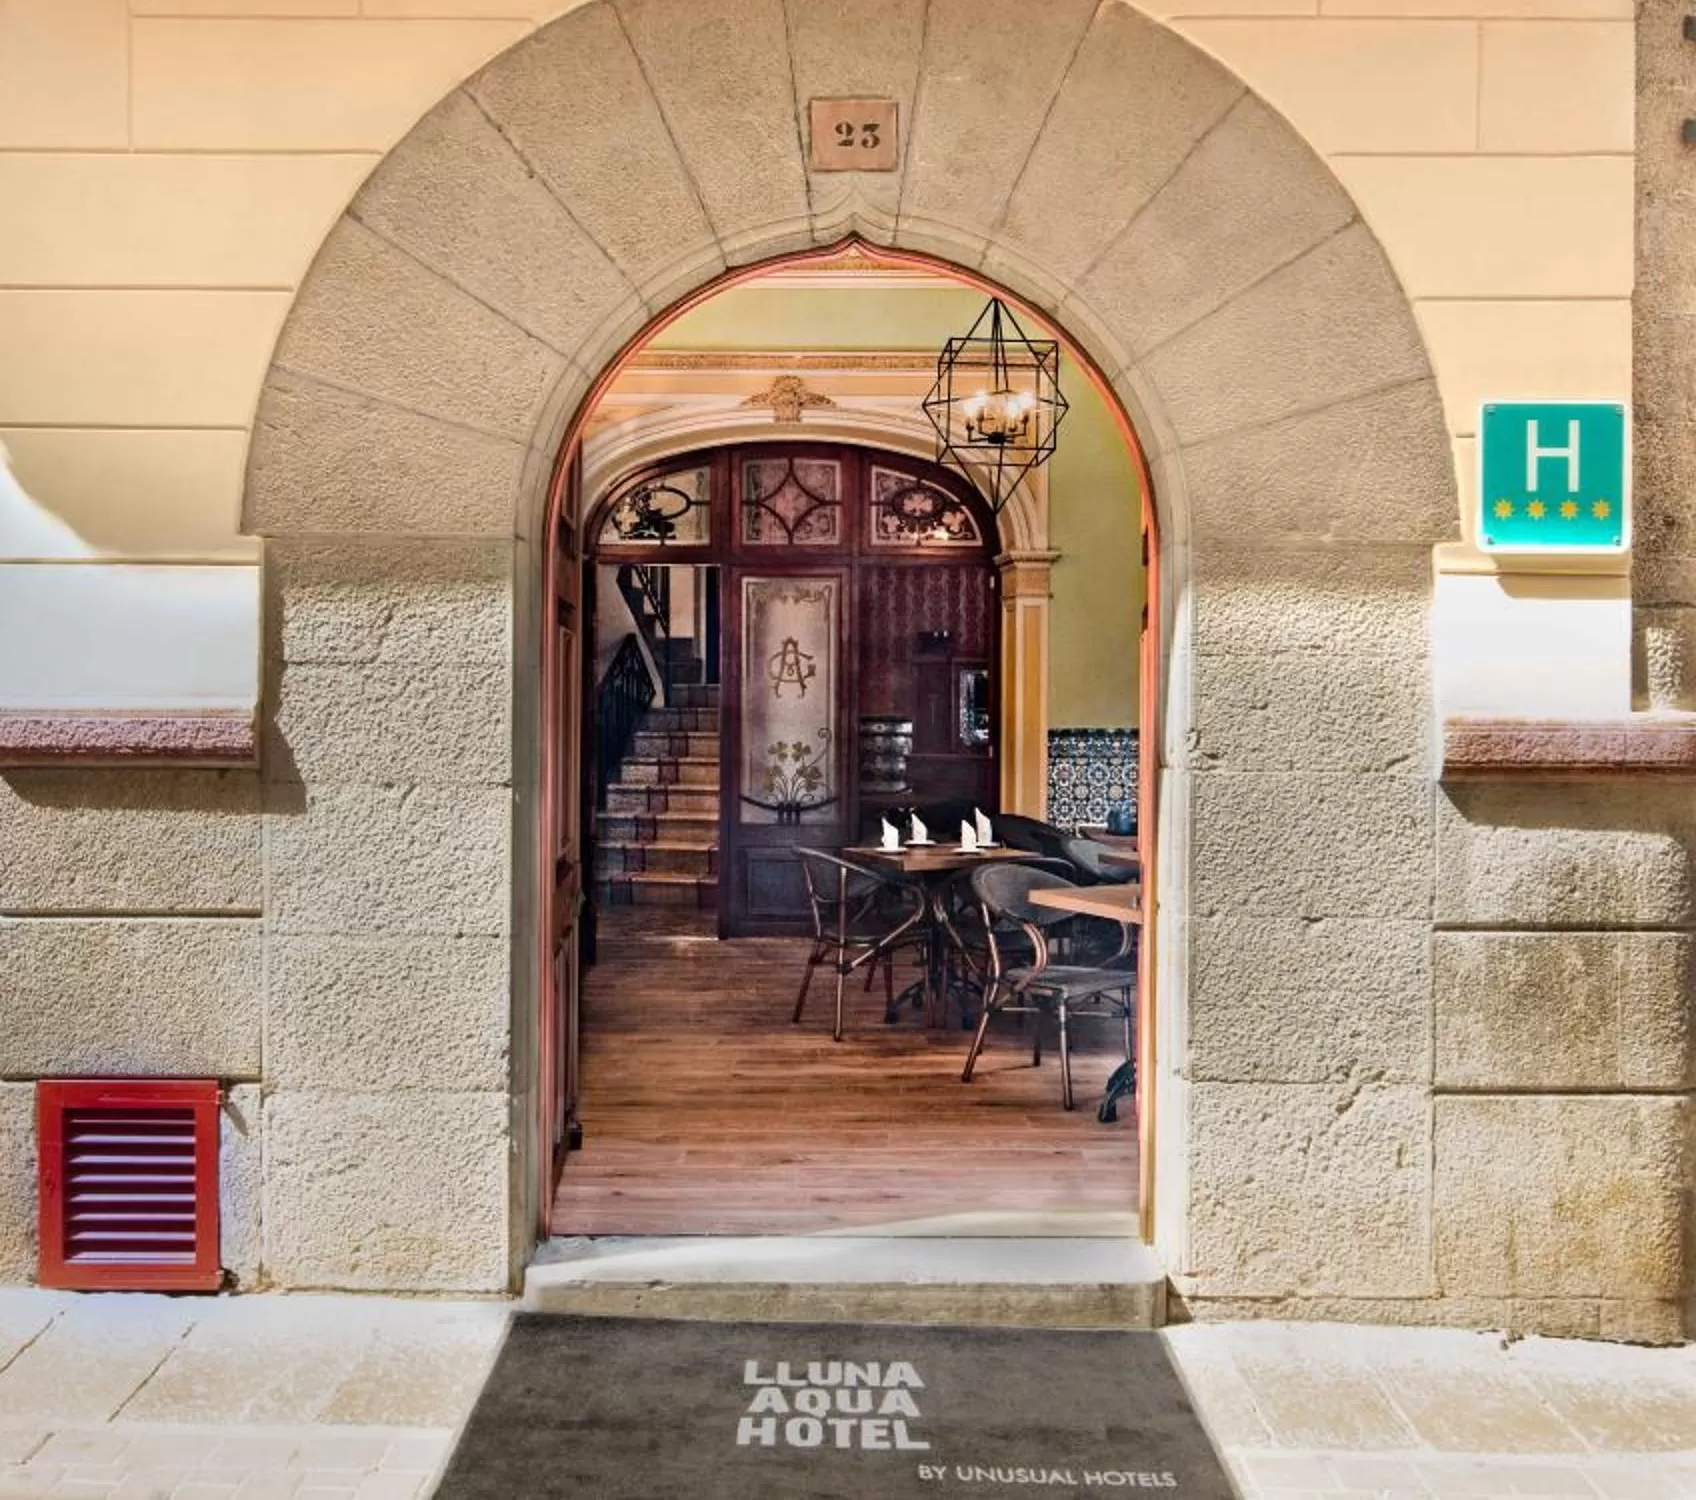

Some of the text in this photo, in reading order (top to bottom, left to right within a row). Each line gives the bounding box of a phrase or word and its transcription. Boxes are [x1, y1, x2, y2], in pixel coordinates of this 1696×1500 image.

[834, 121, 881, 149] 23
[1526, 419, 1580, 493] H
[744, 1359, 924, 1386] LLUNA
[748, 1387, 921, 1417] AQUA
[737, 1417, 931, 1449] HOTEL
[918, 1463, 1177, 1488] BY UNUSUAL HOTELS
